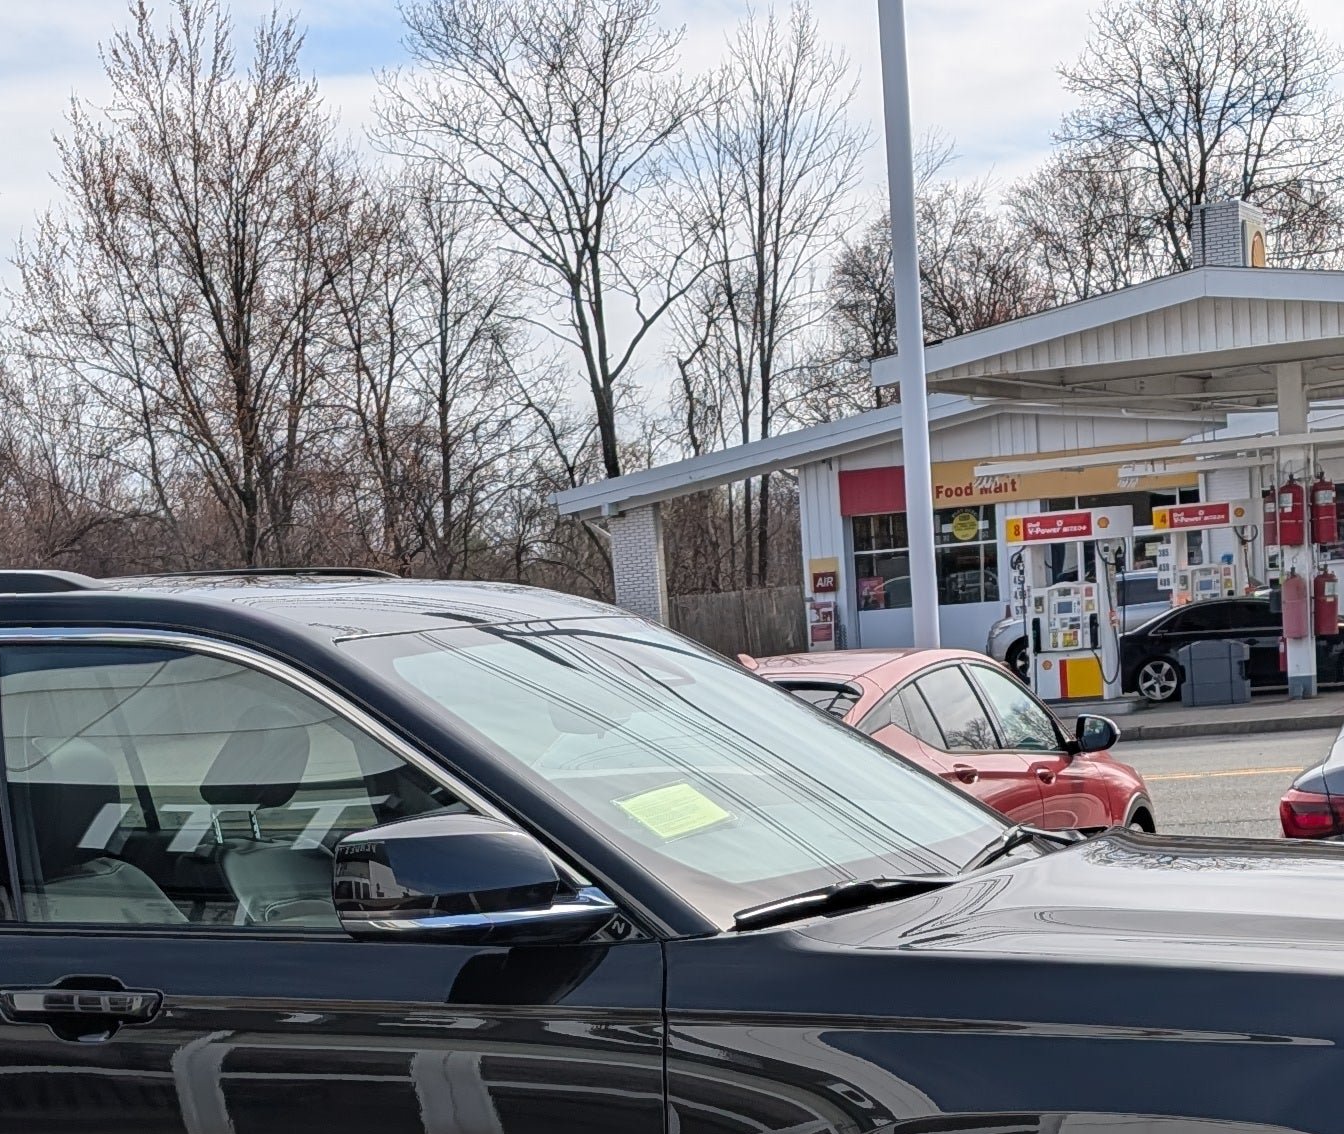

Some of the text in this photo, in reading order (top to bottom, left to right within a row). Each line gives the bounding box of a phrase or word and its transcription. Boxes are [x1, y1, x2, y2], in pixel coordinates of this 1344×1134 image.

[935, 482, 973, 498] Food
[1160, 514, 1167, 524] 4
[1013, 524, 1021, 537] 8
[816, 576, 834, 588] AIR
